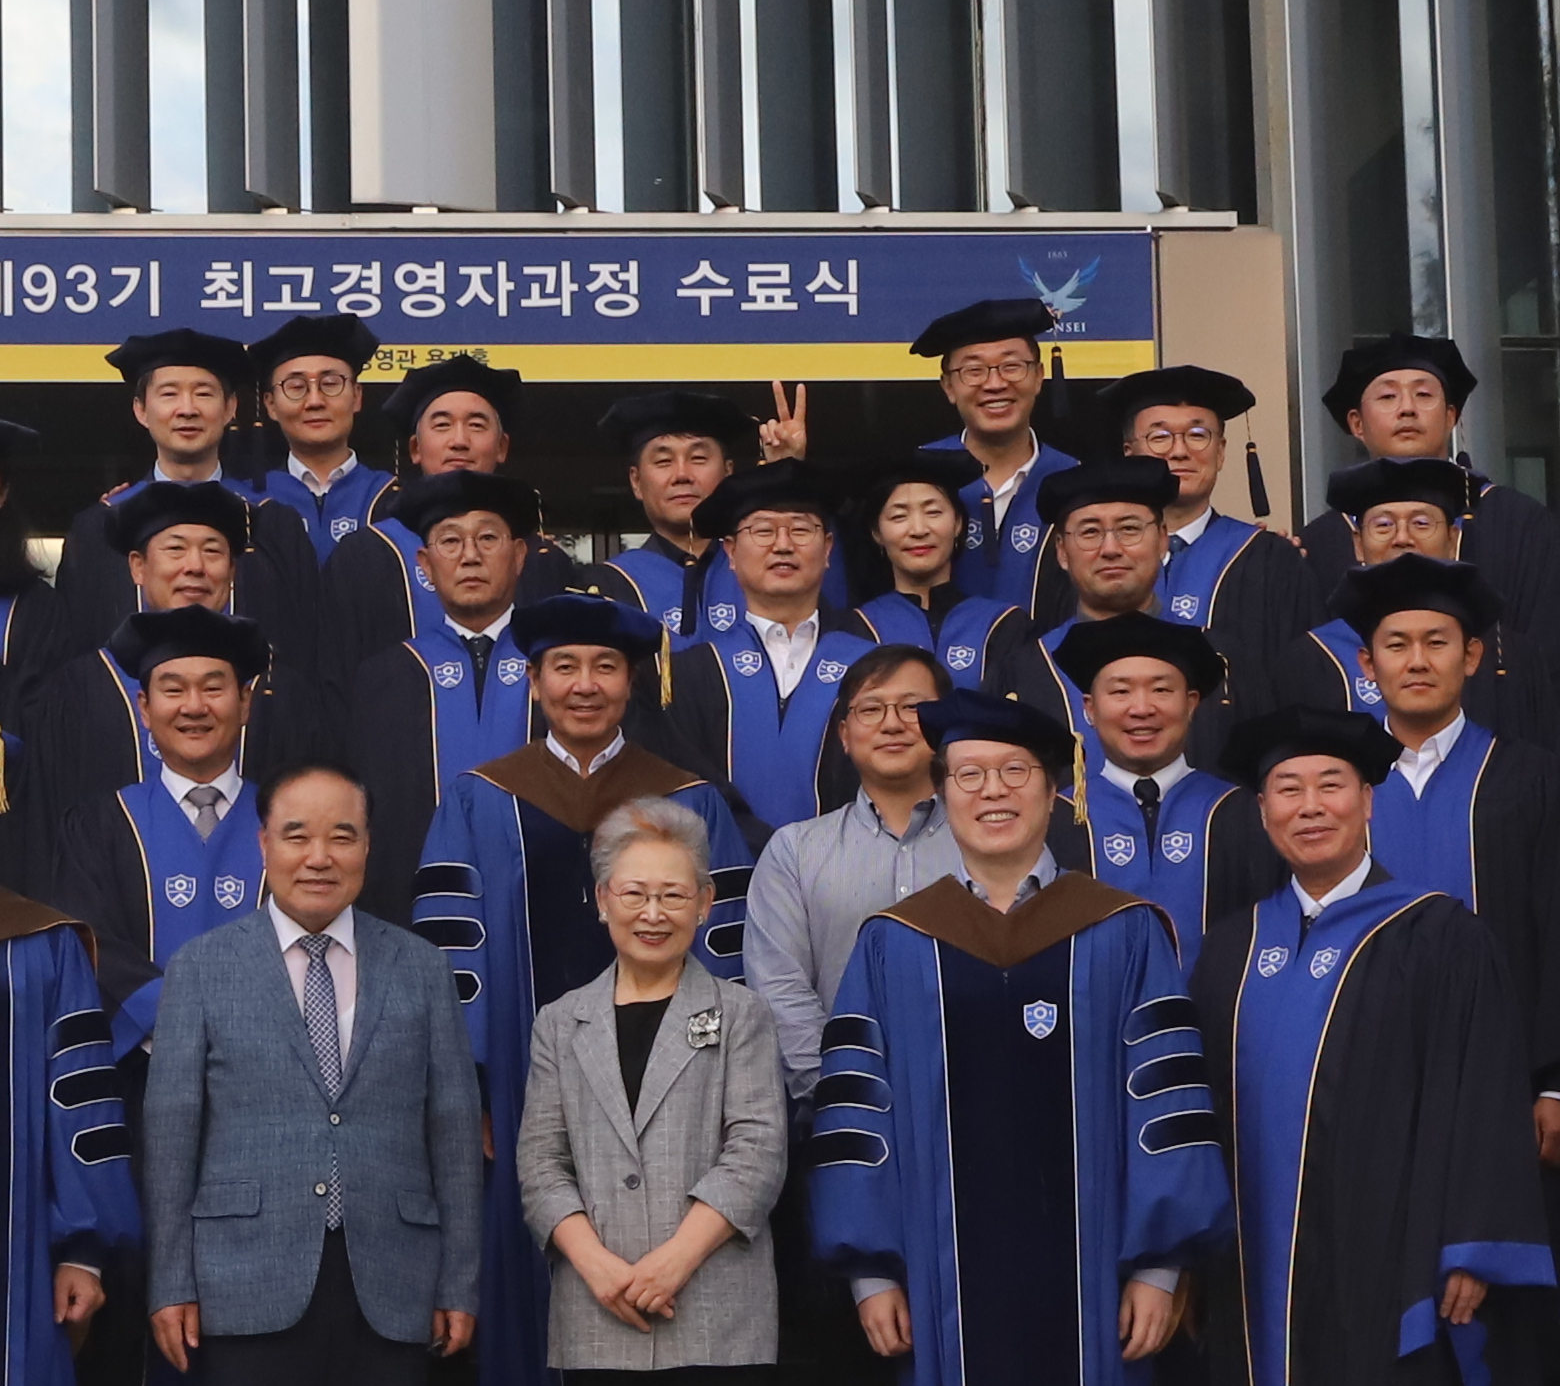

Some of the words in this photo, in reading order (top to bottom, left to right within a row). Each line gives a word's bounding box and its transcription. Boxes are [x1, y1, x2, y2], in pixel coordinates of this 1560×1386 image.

[200, 259, 640, 318] 최고경영자과정
[676, 259, 859, 316] 수료식
[361, 348, 417, 371] 영관
